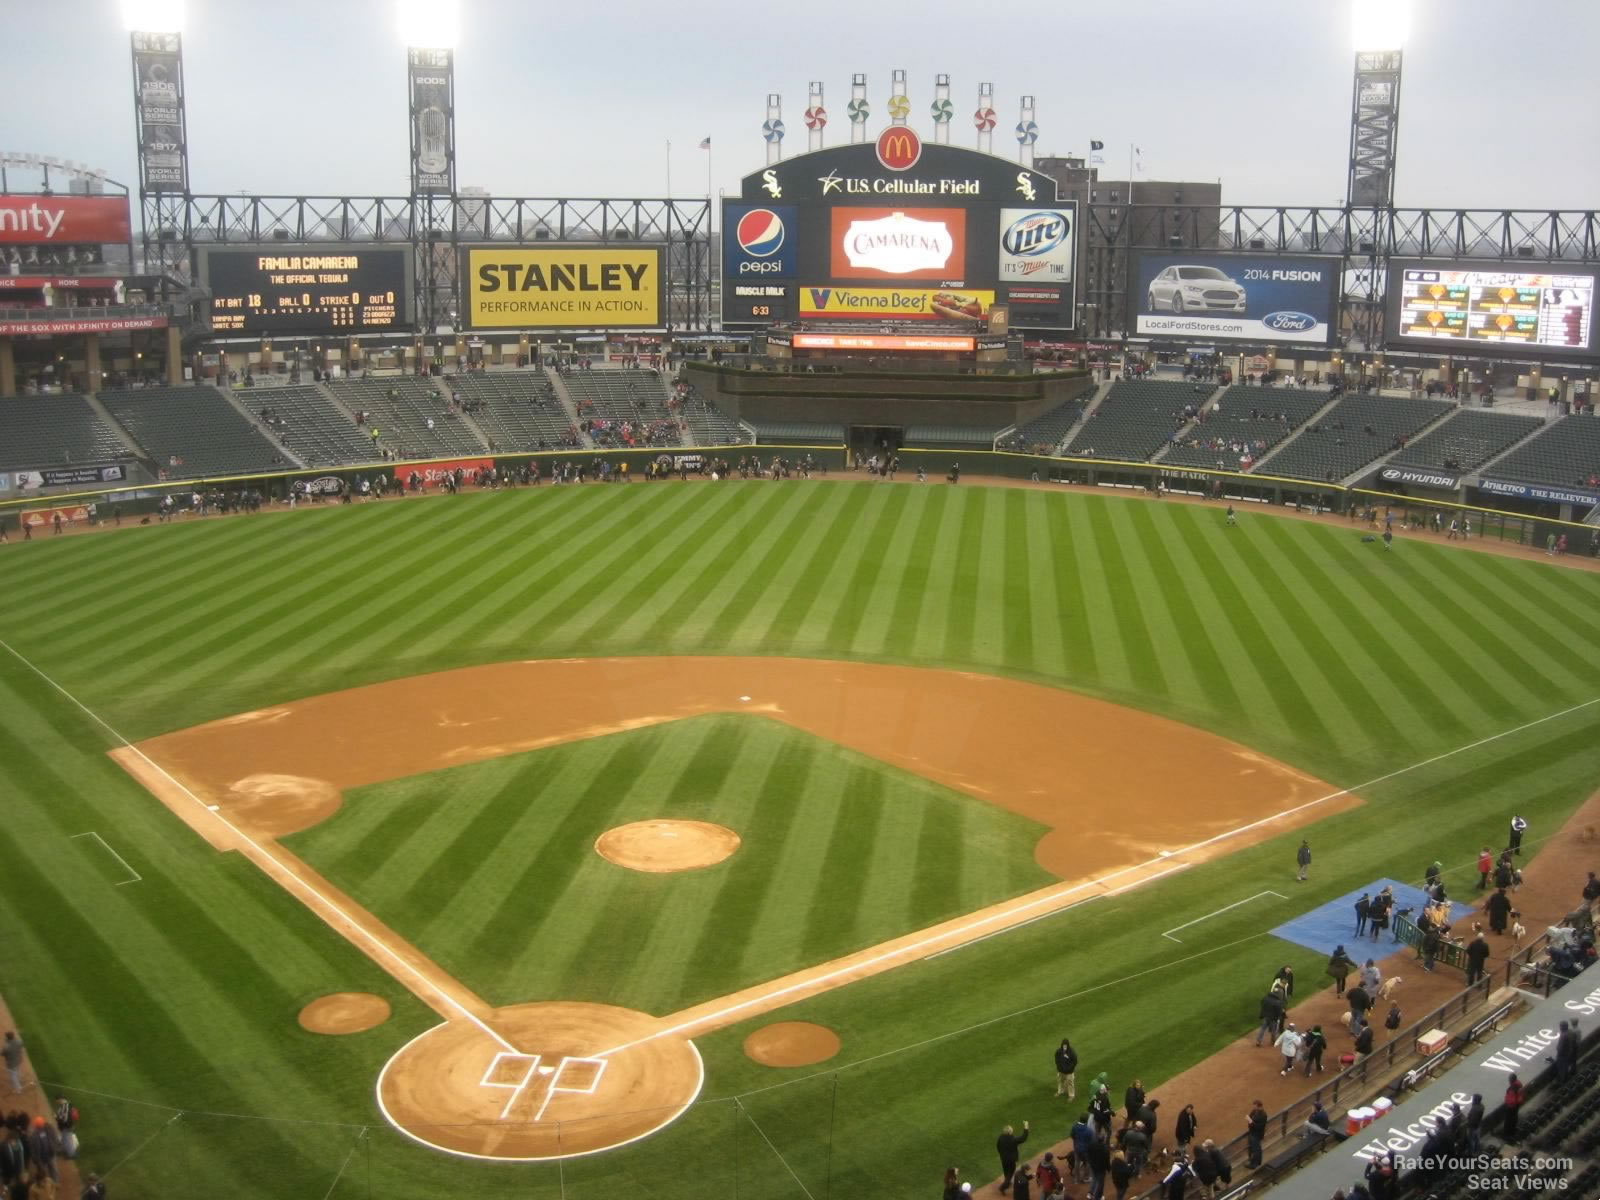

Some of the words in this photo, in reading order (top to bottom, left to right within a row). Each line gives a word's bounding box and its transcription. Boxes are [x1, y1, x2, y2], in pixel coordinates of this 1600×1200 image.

[847, 179, 870, 193] U.S.
[874, 178, 936, 194] Cellular
[940, 179, 980, 194] Field
[854, 232, 940, 254] CAMARENA
[1012, 220, 1061, 256] Lite
[259, 257, 301, 270] FAMILIA
[302, 256, 358, 270] CAMARENA
[740, 260, 782, 274] pepsi
[1005, 264, 1016, 272] IT'S
[1050, 264, 1064, 273] TIME
[271, 275, 284, 284] THE
[286, 275, 316, 284] OFFICIAL
[319, 274, 348, 283] TEQUILA
[479, 264, 648, 292] STANLEY
[1244, 269, 1270, 280] 2014
[1272, 270, 1321, 282] FUSION
[736, 287, 764, 295] MUSCLE
[766, 287, 784, 296] MILK
[215, 299, 225, 307] AT
[228, 299, 243, 307] BAT
[248, 294, 261, 307] 18
[279, 298, 299, 306] BALL
[320, 296, 349, 305] STRIKE
[370, 295, 384, 304] OUT
[835, 293, 888, 307] Vienna
[892, 292, 927, 312] Beef
[480, 302, 574, 312] PERFORMANCE
[579, 301, 590, 311] IN
[78, 321, 109, 330] XFINITY
[1146, 320, 1243, 332] LocalFordStores.com
[1272, 314, 1305, 330] Ford
[1402, 472, 1454, 487] HYUNDAI
[1482, 480, 1525, 493] ATHLETICO
[1531, 489, 1547, 498] THE
[1550, 492, 1597, 504] RELIEVERS
[1480, 1028, 1561, 1073] White
[1352, 1092, 1473, 1162] Welcome
